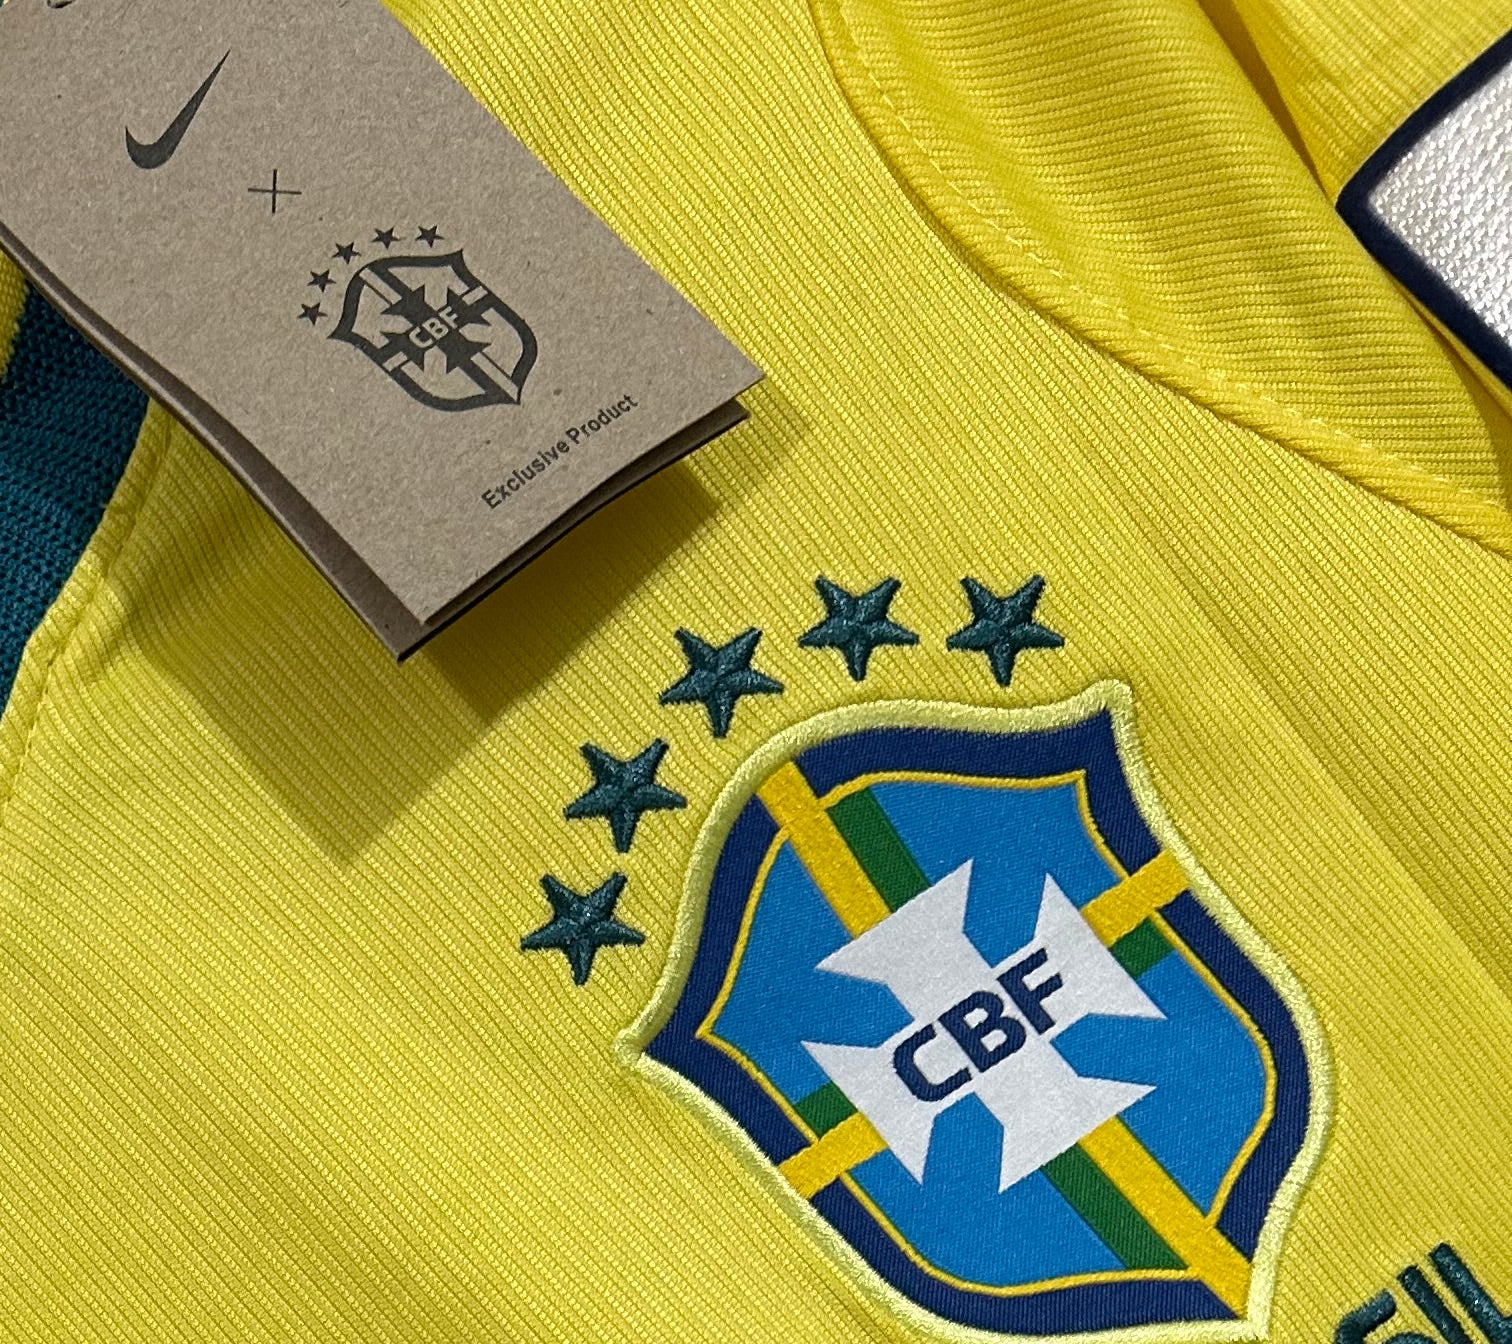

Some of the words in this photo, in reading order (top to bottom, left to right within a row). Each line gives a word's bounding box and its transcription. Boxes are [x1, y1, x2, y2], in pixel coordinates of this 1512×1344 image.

[408, 306, 459, 348] CBF
[481, 440, 570, 509] Exclusive
[565, 394, 639, 445] Product
[889, 946, 1065, 1104] CBF
